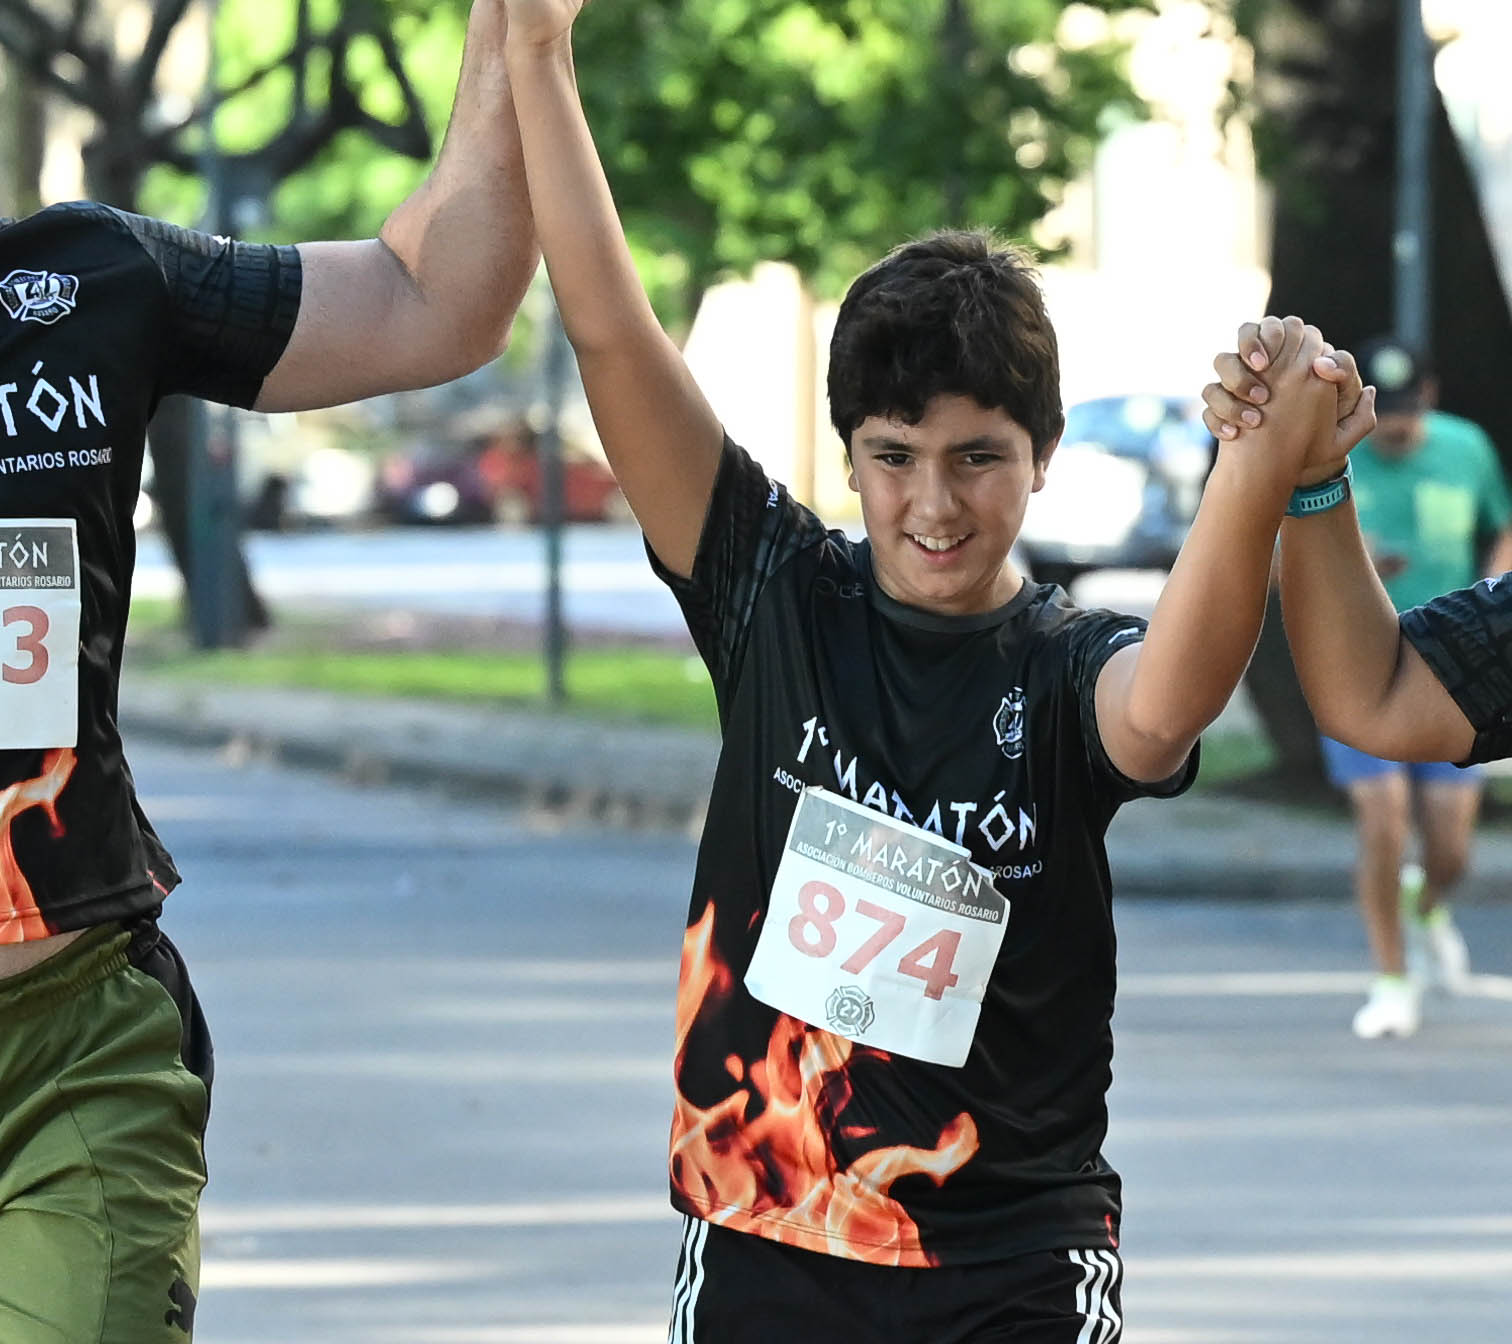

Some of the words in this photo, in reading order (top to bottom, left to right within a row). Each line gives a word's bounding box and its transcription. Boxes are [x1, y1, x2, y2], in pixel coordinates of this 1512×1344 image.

[34, 575, 71, 587] ROSARIO
[847, 862, 895, 890] BOMBEROS
[896, 880, 958, 913] VOLUNTARIOS
[958, 903, 999, 921] ROSARIO
[851, 832, 983, 899] MARATÓN
[788, 880, 962, 1001] 874
